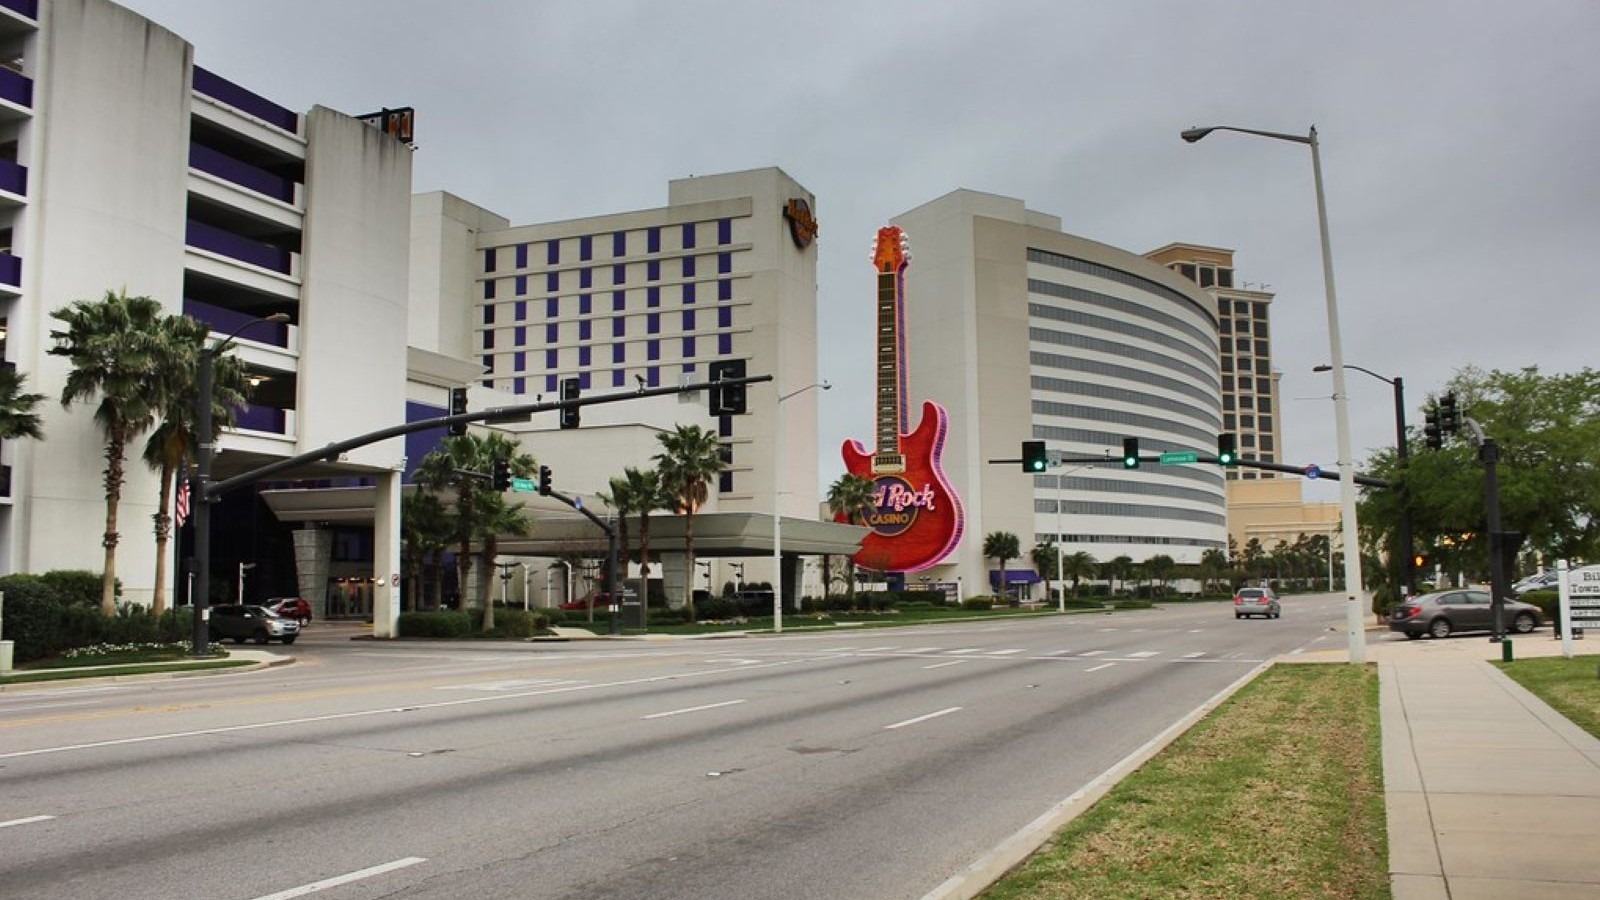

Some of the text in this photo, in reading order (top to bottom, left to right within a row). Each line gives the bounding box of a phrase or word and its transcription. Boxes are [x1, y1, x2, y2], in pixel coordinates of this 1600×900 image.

[887, 483, 935, 512] Rock
[870, 513, 910, 525] CASINO
[1570, 583, 1600, 593] Town
